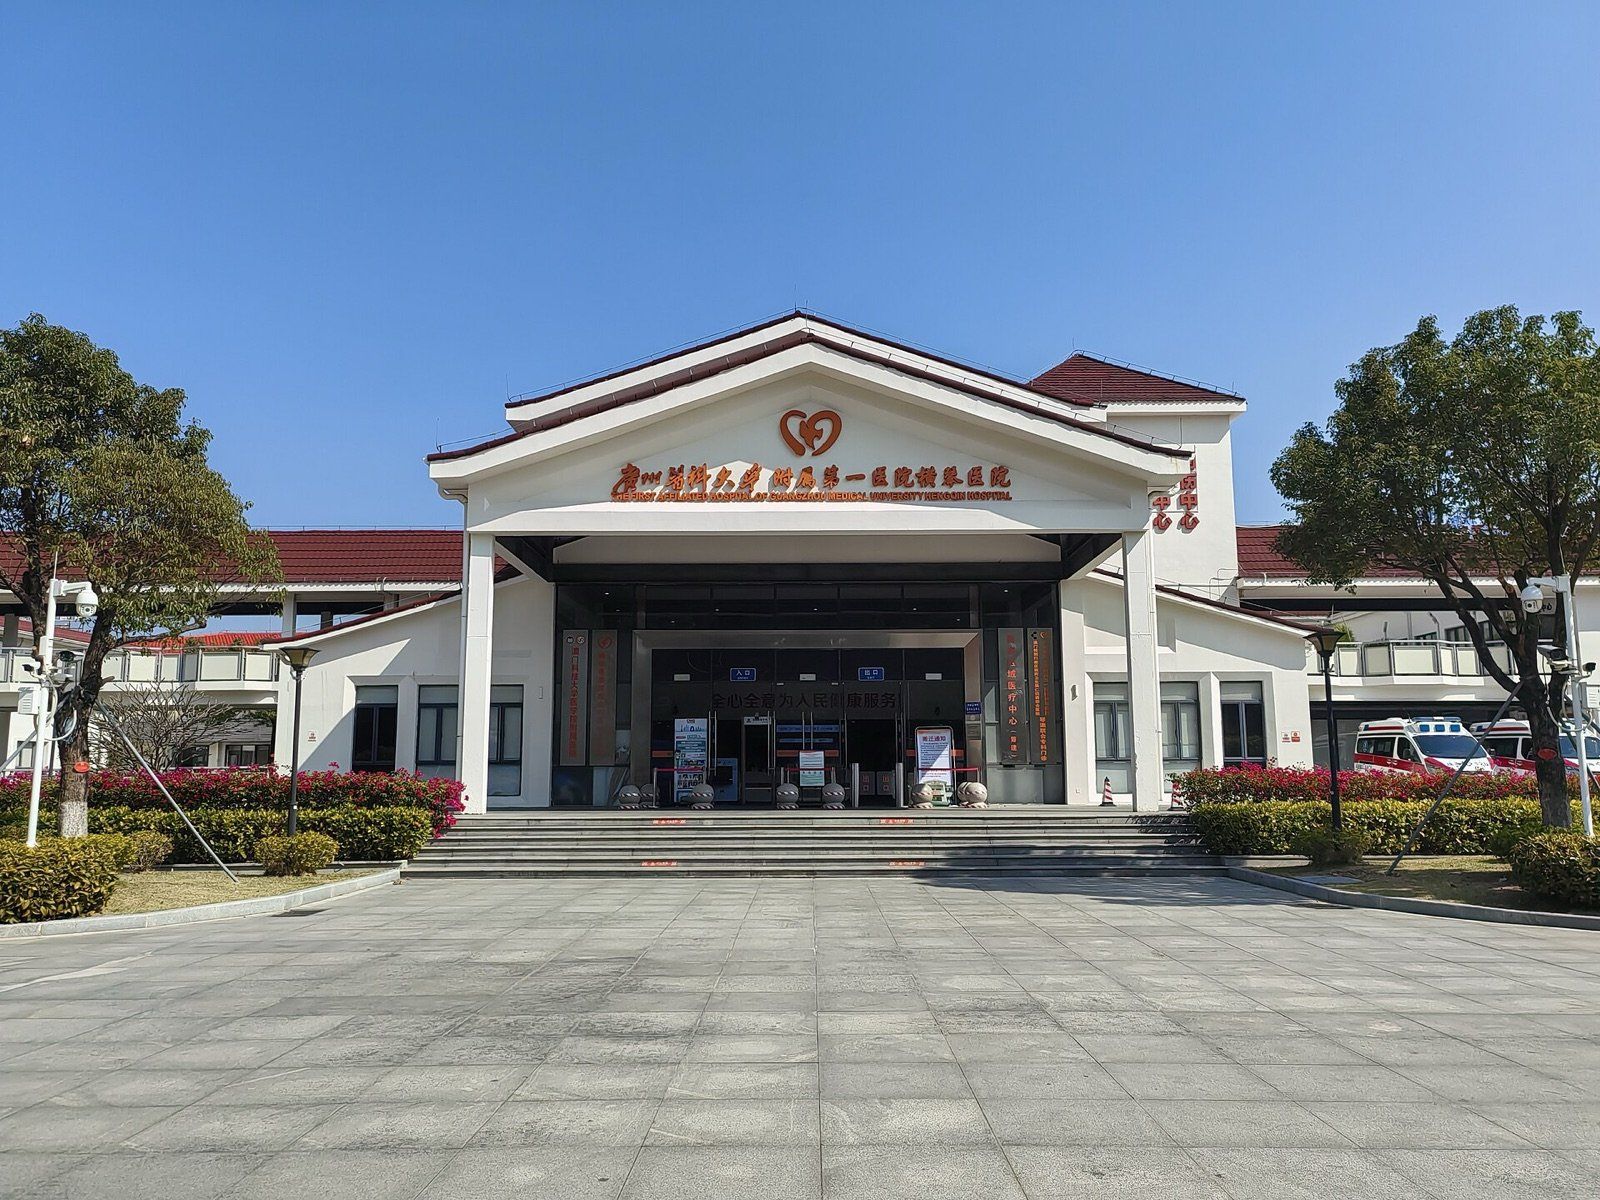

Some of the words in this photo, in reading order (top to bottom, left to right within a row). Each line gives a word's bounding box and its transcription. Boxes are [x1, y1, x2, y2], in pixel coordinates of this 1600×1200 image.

[632, 492, 655, 501] FIRST
[659, 492, 707, 501] AFFILIATED
[710, 492, 751, 501] HOSPITAL
[755, 492, 767, 501] OF
[770, 492, 826, 501] GUANGZHOU
[828, 492, 868, 501] MEDICAL
[870, 492, 923, 501] UNIVERSITY
[925, 492, 965, 501] HENGQIN
[967, 492, 1012, 501] HOSPITAL
